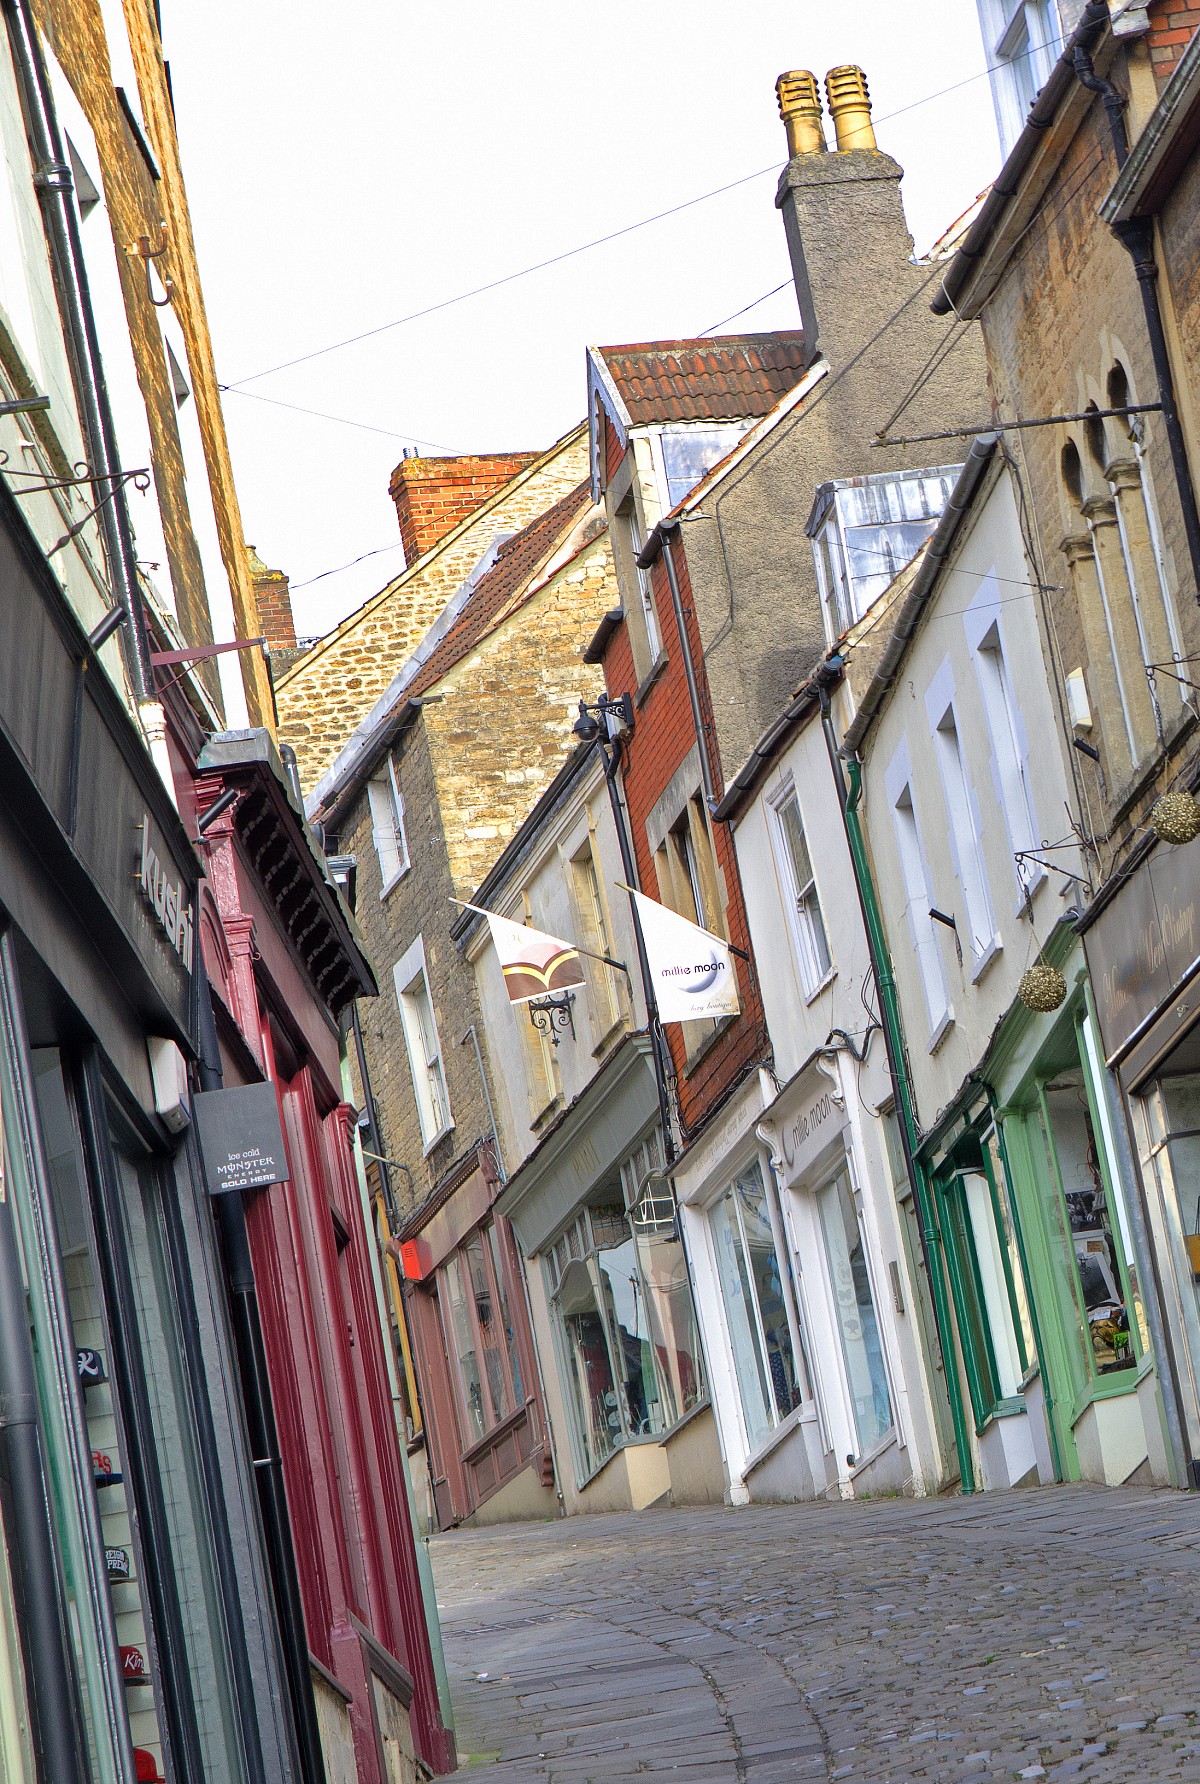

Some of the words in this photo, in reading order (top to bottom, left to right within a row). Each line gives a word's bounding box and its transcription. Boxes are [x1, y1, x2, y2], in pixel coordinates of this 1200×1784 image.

[141, 813, 193, 976] kushi
[661, 966, 691, 977] millie
[694, 962, 725, 974] moon
[792, 1113, 810, 1149] millie
[810, 1093, 831, 1131] moon
[242, 1148, 261, 1158] cold
[217, 1157, 275, 1174] MONSTER
[221, 1179, 247, 1188] SOLD
[251, 1173, 276, 1183] HERE
[227, 1168, 267, 1179] ENERGY
